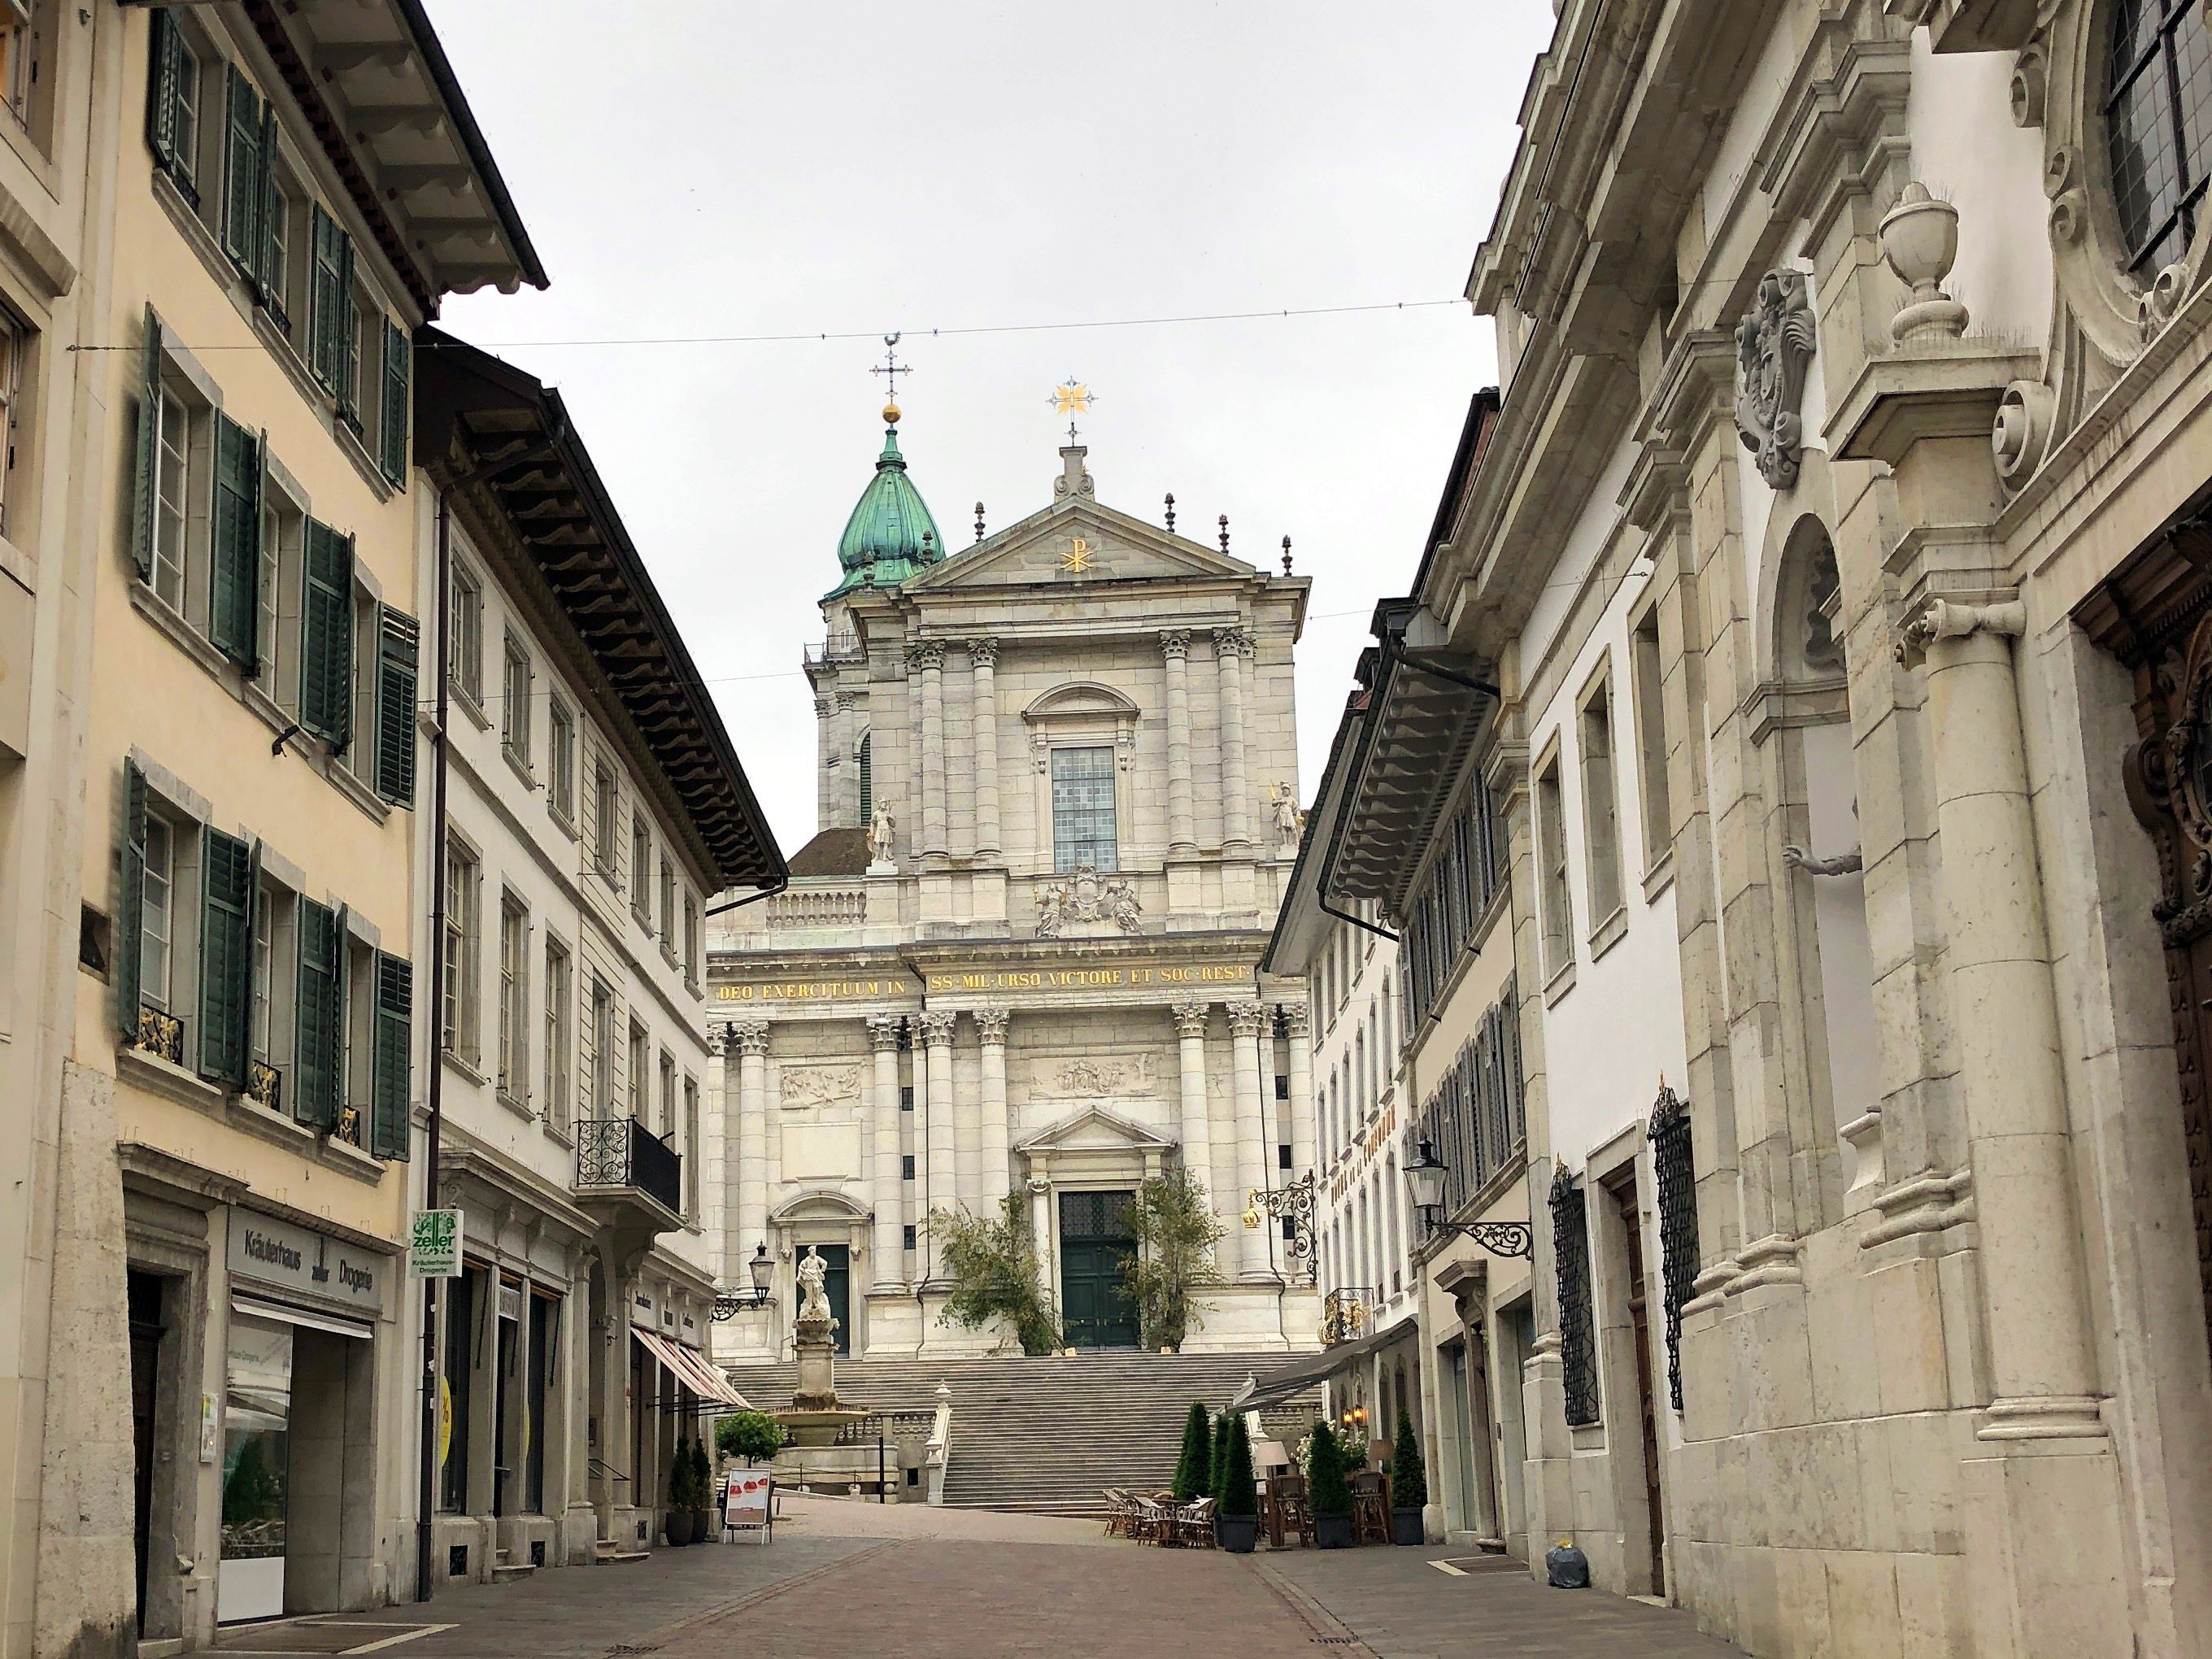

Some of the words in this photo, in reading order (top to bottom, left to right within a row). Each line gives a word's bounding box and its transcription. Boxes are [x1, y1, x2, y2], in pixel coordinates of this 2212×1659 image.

[997, 973, 1042, 987] URSO
[1047, 970, 1123, 986] VICTORE
[1131, 969, 1152, 982] ET
[719, 986, 754, 1000] DEO
[762, 982, 879, 999] EXERCITUUM
[887, 981, 906, 995] IN
[245, 1229, 301, 1271] Kräuterhaus
[339, 1259, 373, 1293] Drogerie
[419, 1266, 447, 1274] Drogerie
